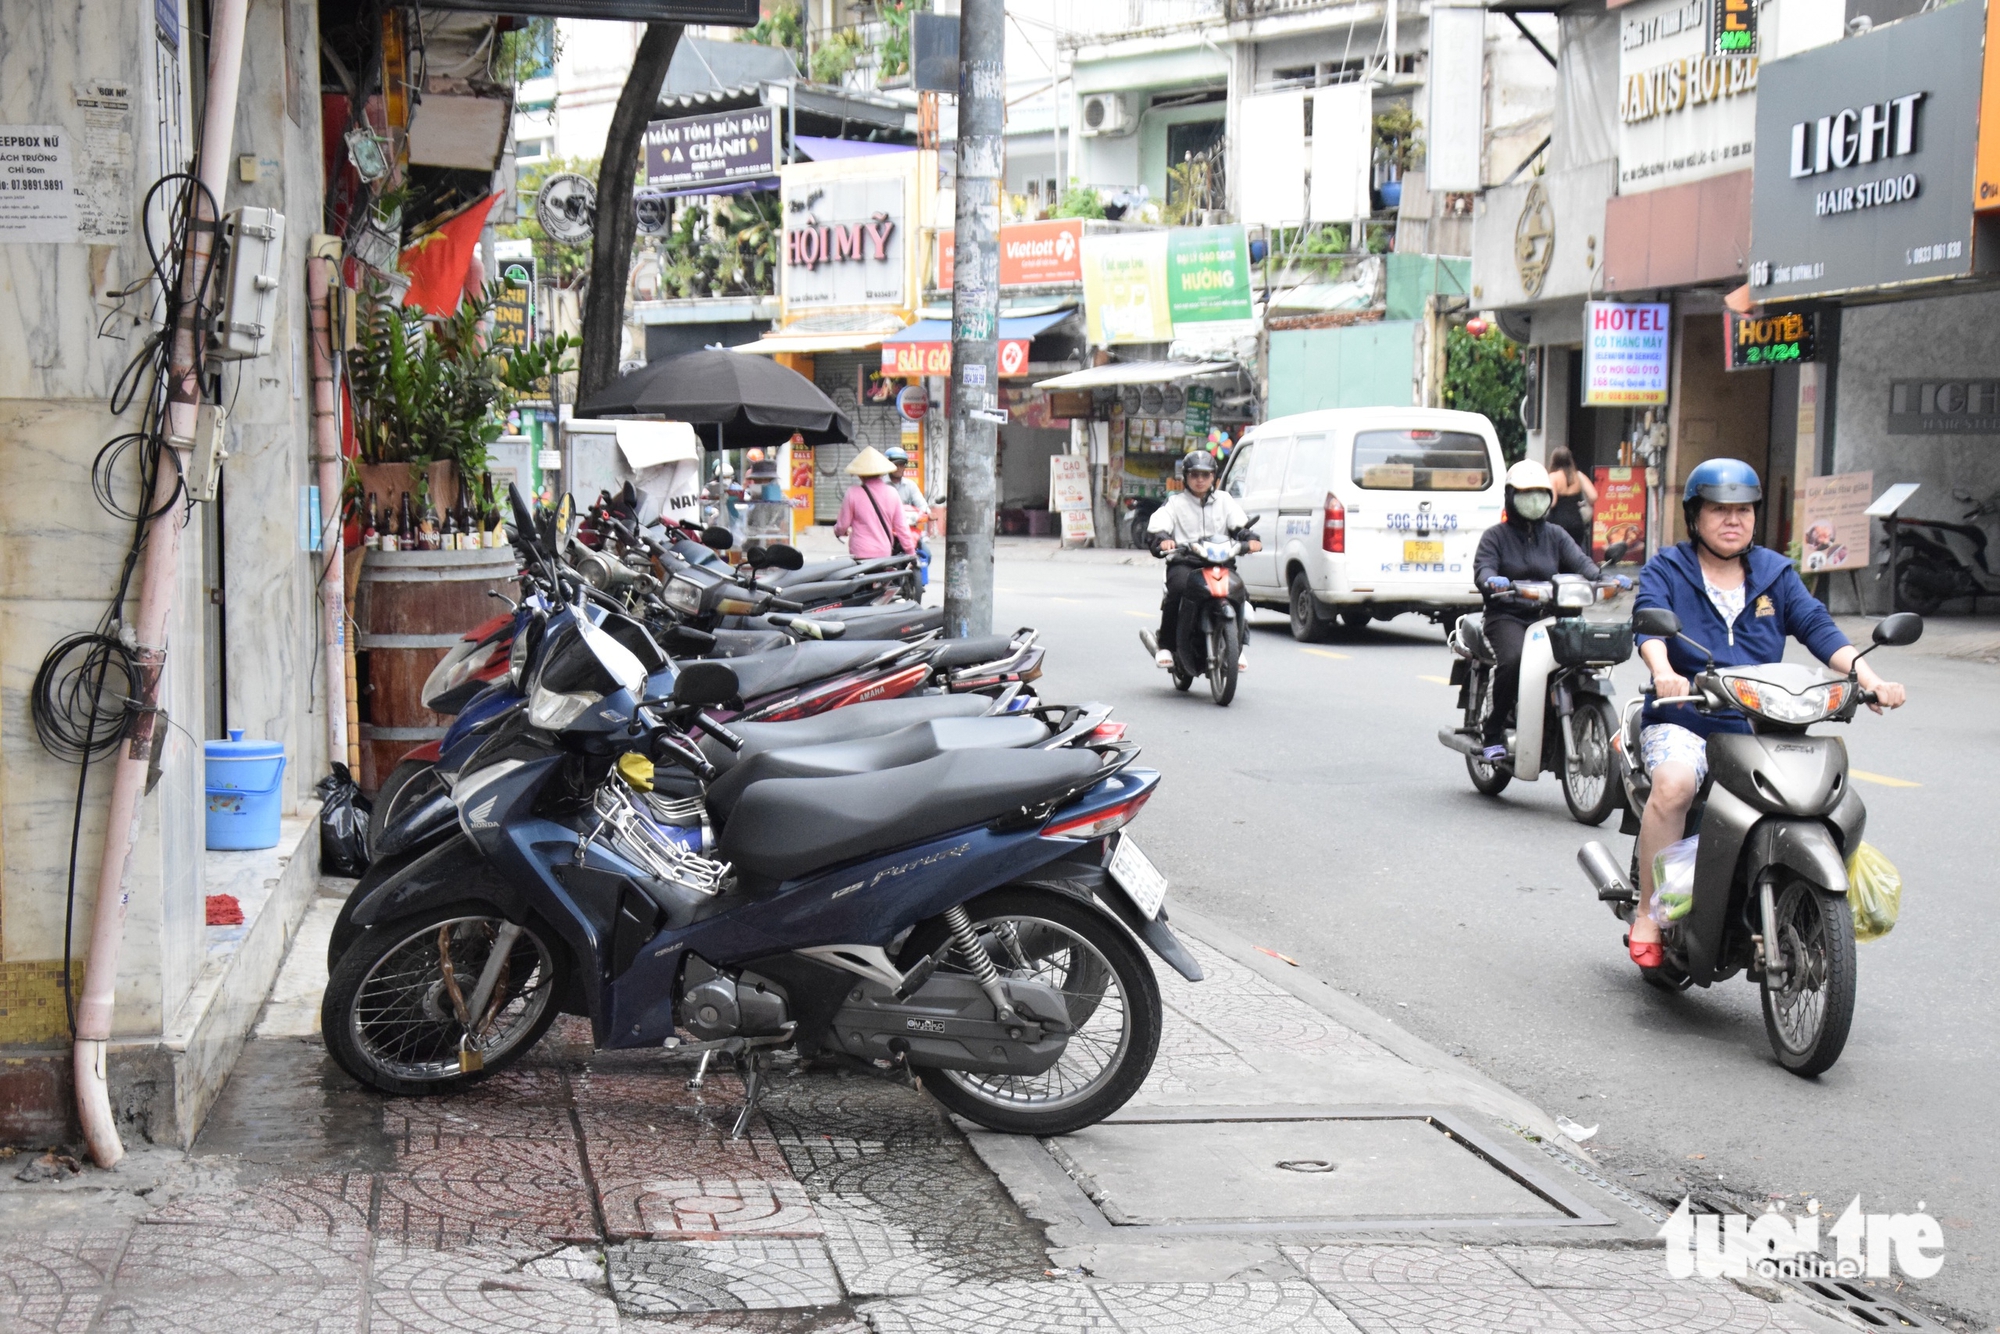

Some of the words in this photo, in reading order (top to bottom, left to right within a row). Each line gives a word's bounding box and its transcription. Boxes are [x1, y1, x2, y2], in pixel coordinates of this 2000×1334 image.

[1647, 17, 1658, 43] TY
[1721, 31, 1751, 49] 24/24
[1621, 57, 1684, 123] JANUS
[1686, 53, 1757, 105] HOTEL
[682, 122, 711, 142] TÔM
[713, 117, 739, 138] BÚN
[741, 113, 769, 137] ĐẬU
[1790, 91, 1922, 179] LIGHT
[44, 135, 60, 148] NỮ
[22, 153, 58, 162] TRƯỜNG
[671, 146, 685, 163] A
[26, 166, 46, 174] 50m
[11, 179, 64, 191] 07.9891.9891
[1816, 186, 1853, 217] HAIR
[1855, 173, 1917, 209] STUDIO
[787, 213, 830, 272] HỘI
[834, 211, 895, 261] MỸ
[1006, 238, 1054, 258] Vietlott
[1181, 267, 1235, 292] HƯỜNG
[1750, 259, 1769, 287] 166
[1594, 308, 1664, 331] HOTEL
[1739, 313, 1810, 346] HOTEL
[1594, 334, 1607, 348] CÓ
[1610, 335, 1641, 348] THANG
[1643, 333, 1664, 348] MÁY
[897, 344, 926, 372] SÀI
[1592, 376, 1608, 387] 168
[1386, 513, 1458, 530] 50G-014.26
[1616, 511, 1642, 520] LOAN
[1415, 541, 1433, 551] 50G
[1381, 563, 1462, 572] KENBO
[859, 685, 885, 702] AMAHA
[831, 880, 865, 900] 125
